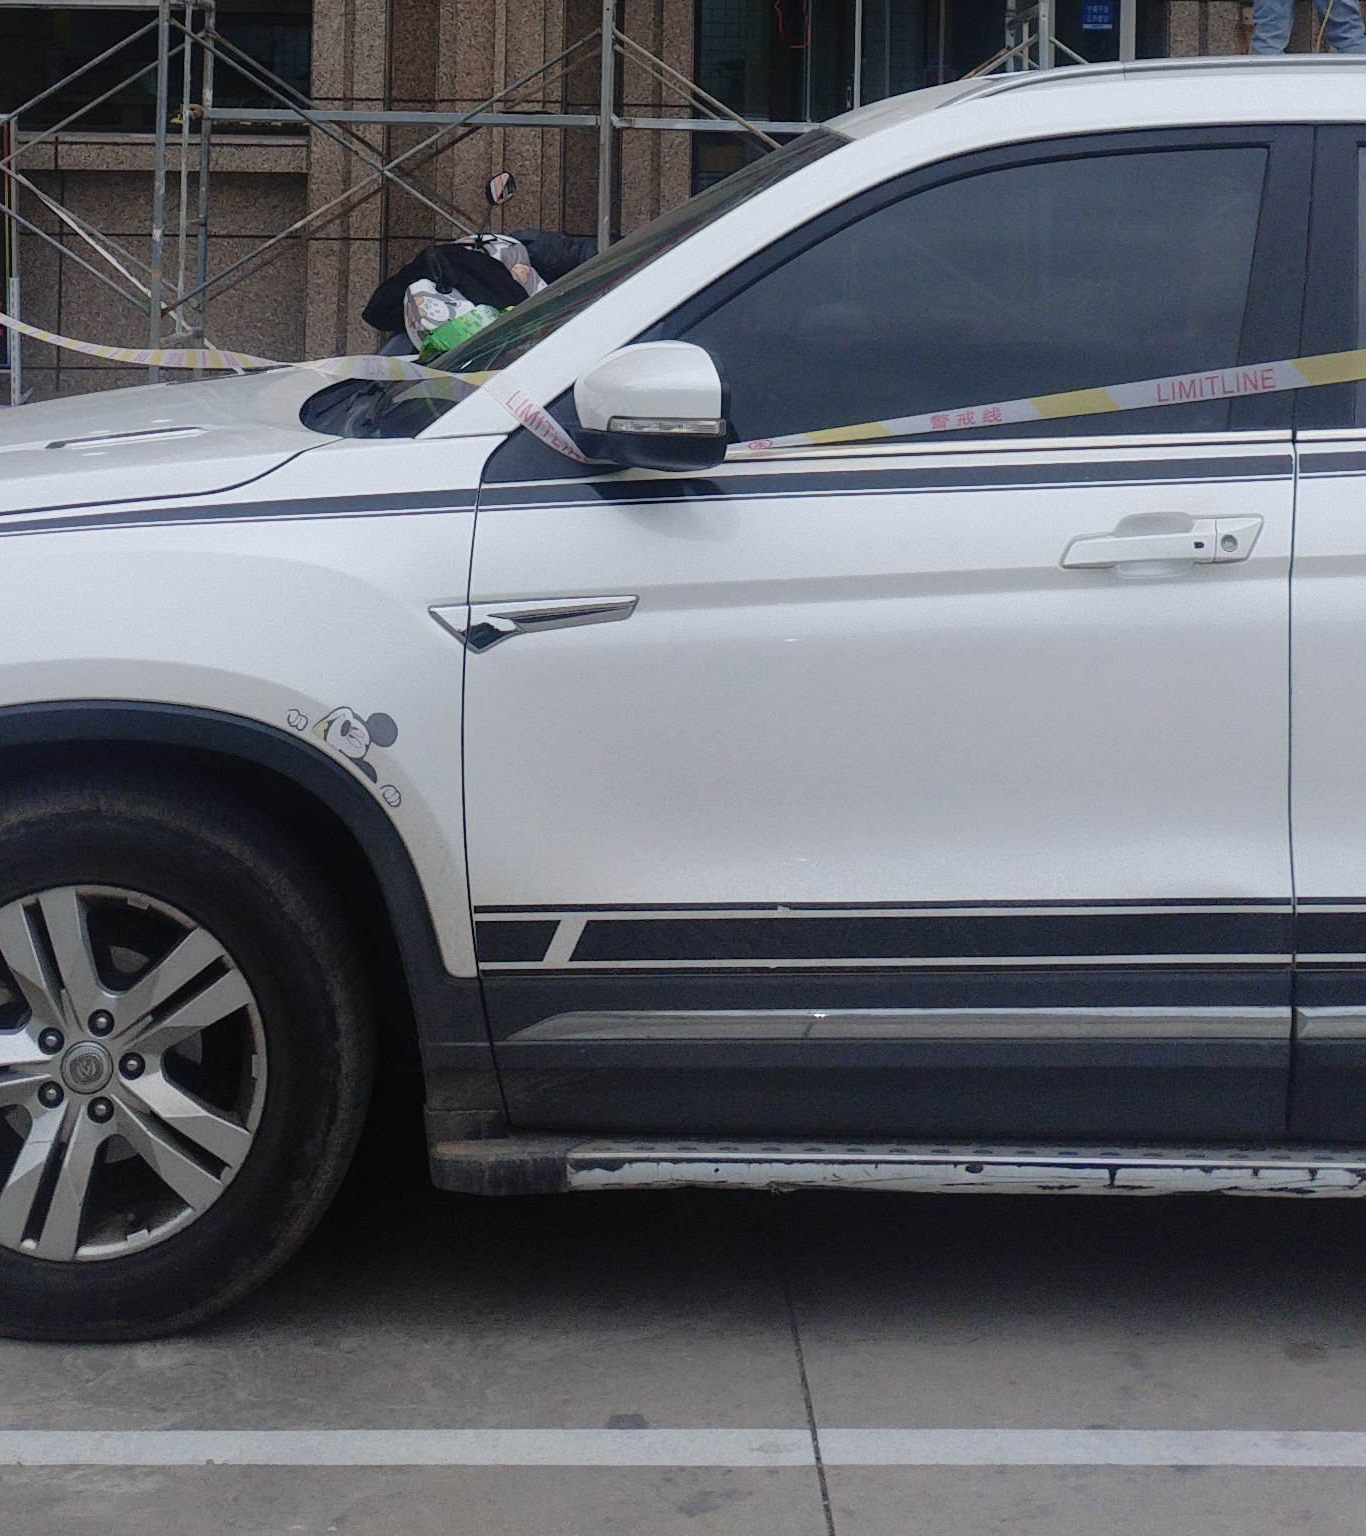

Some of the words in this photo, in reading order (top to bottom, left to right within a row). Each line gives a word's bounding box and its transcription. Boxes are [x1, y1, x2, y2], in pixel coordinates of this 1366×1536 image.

[1155, 368, 1277, 405] LIMITLINE
[929, 406, 1004, 431] 警戒线
